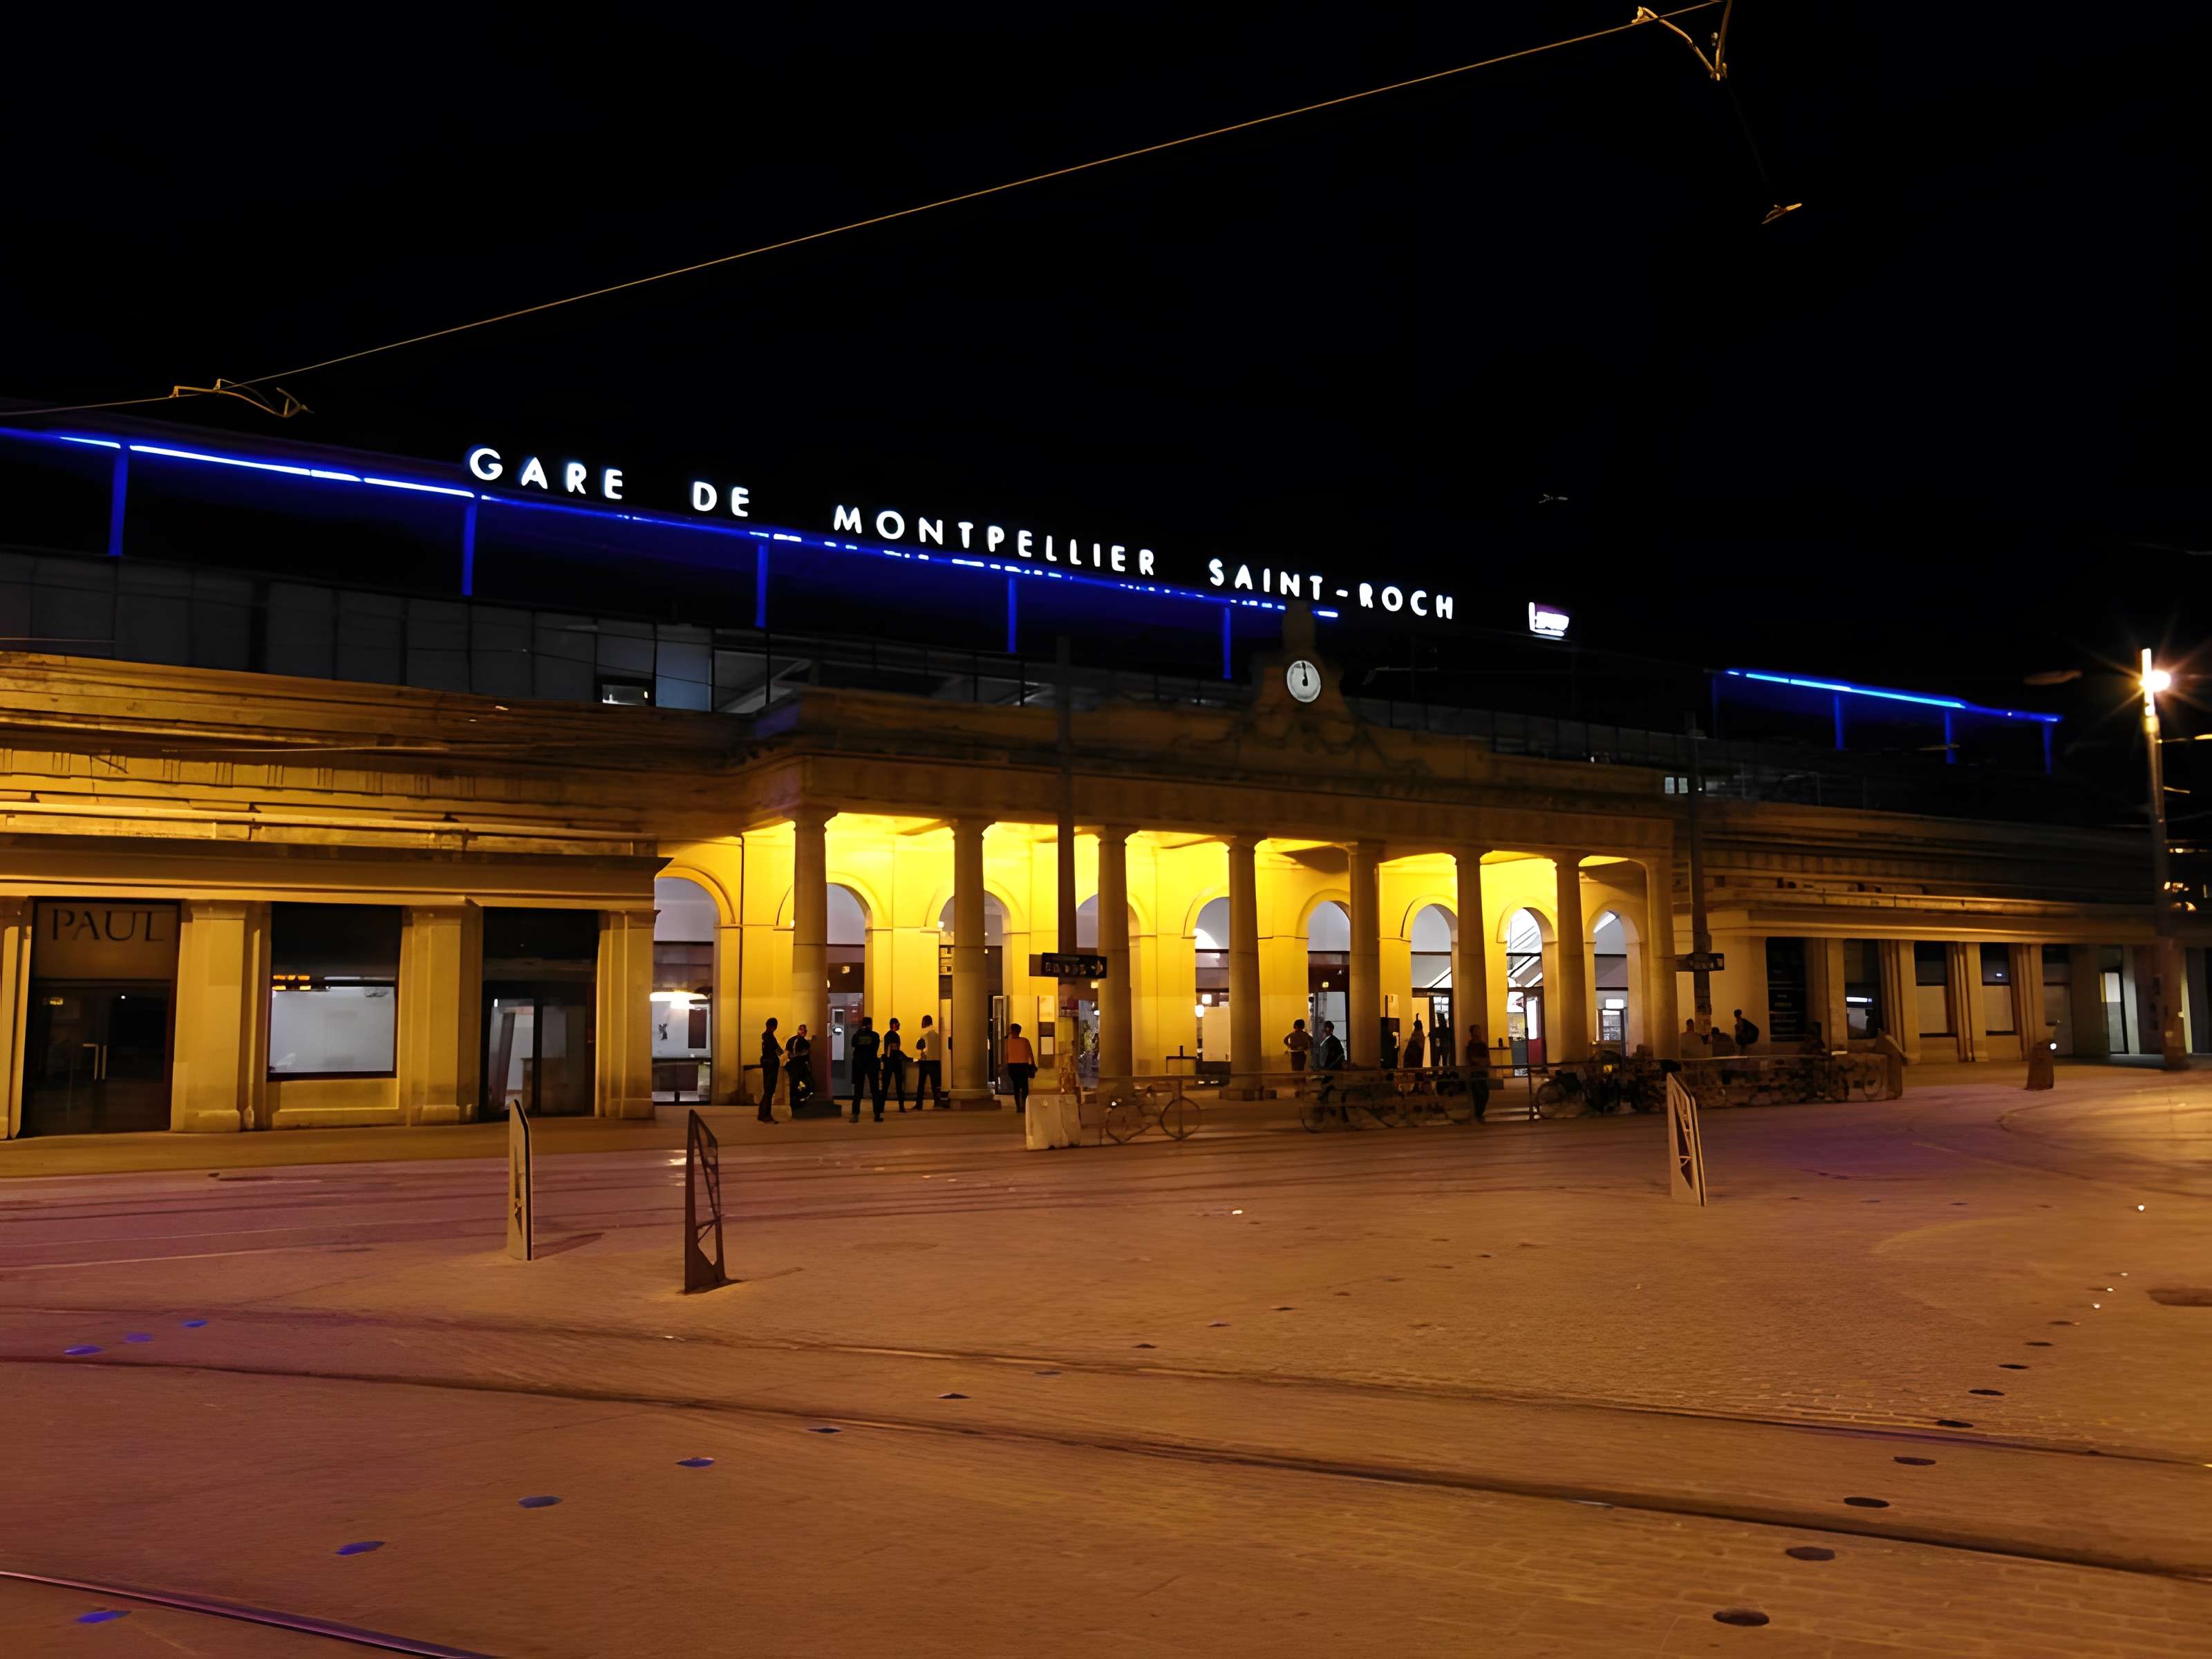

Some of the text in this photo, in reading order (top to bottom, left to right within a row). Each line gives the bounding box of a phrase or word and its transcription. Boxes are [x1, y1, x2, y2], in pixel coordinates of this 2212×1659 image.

[469, 447, 1454, 621] GARE DE MONTPELLIER SAINT-ROCH
[53, 908, 165, 941] PAUL
